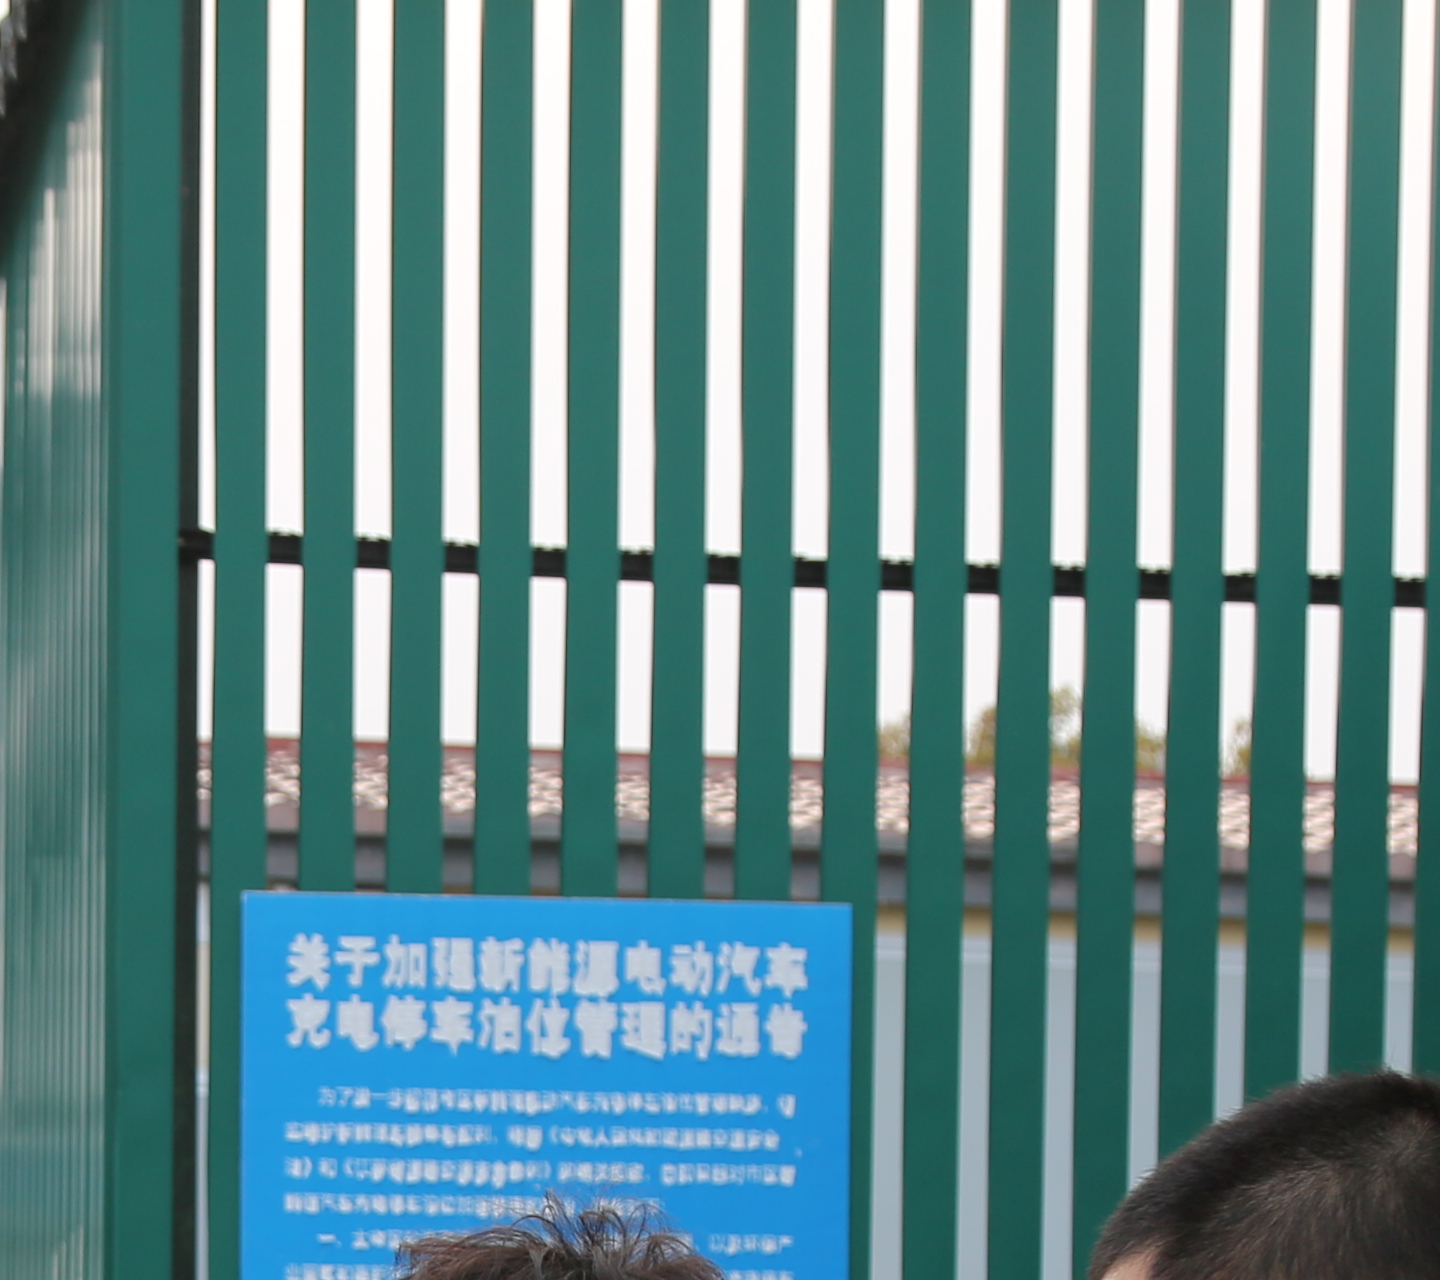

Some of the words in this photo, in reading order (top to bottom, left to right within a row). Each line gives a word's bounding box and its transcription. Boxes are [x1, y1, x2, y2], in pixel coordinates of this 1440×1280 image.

[286, 932, 809, 999] 关于加强新能源电动汽车
[286, 993, 809, 1061] 充电停车泊位管理的通告
